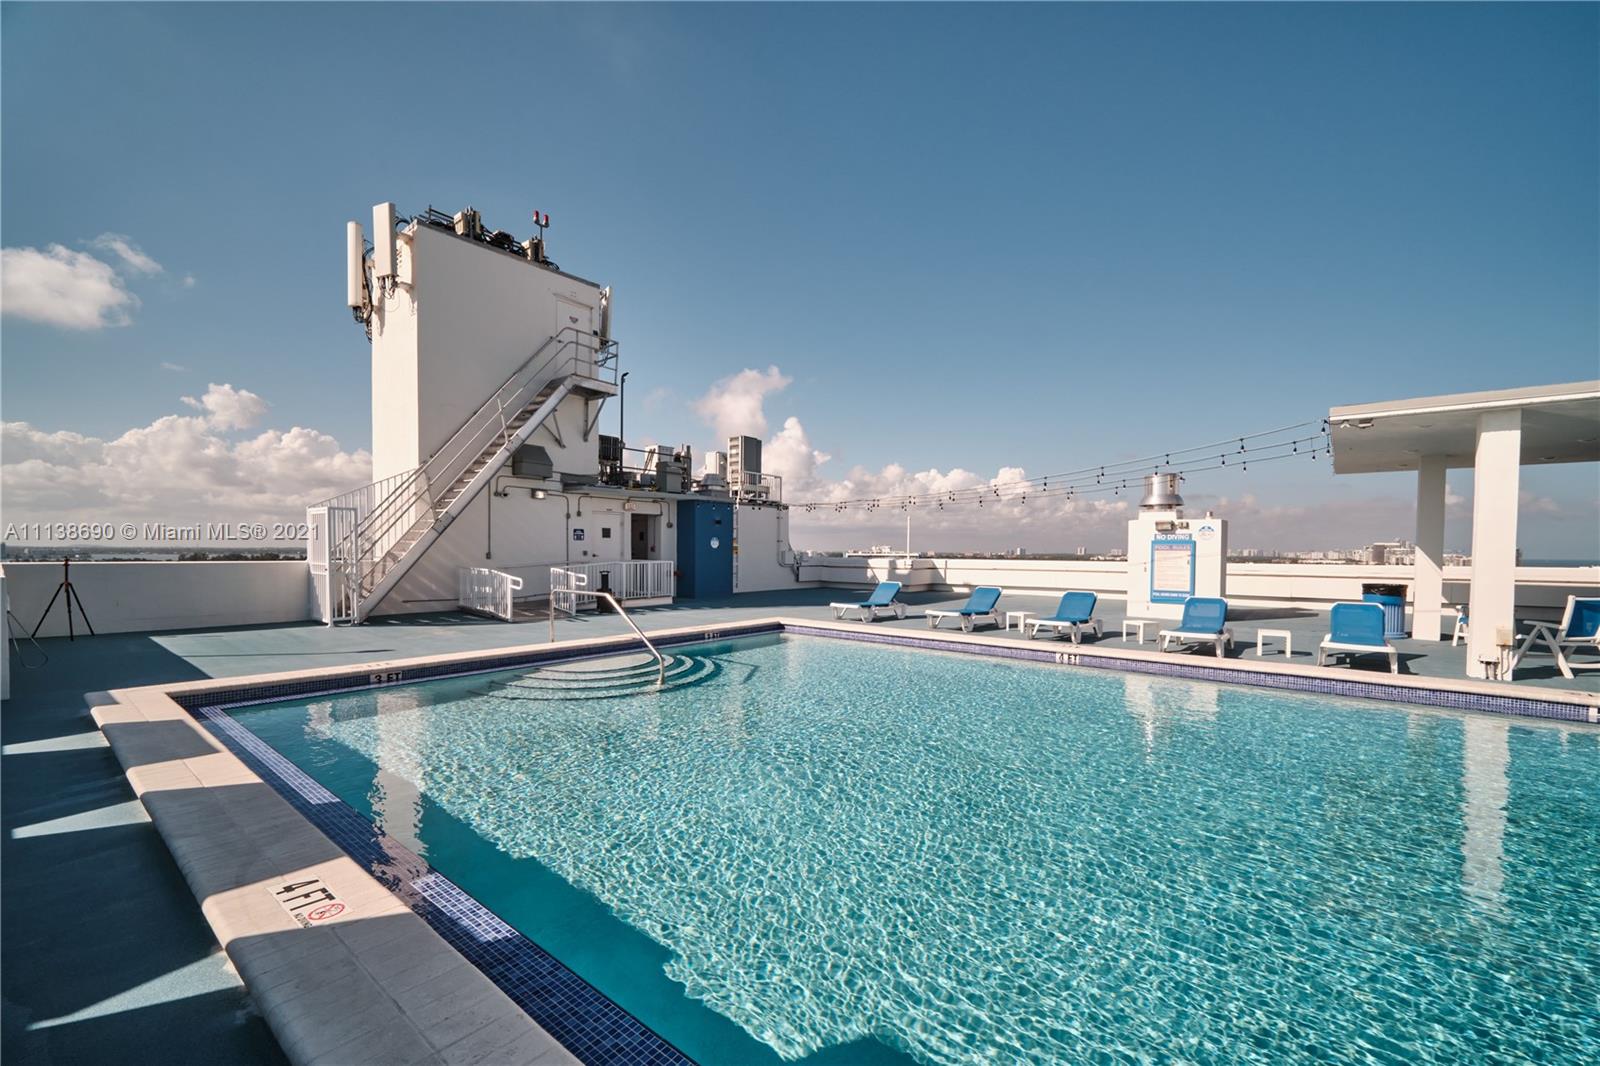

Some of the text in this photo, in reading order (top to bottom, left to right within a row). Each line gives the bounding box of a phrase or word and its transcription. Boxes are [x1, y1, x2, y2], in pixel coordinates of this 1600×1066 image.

[386, 672, 401, 683] FT
[276, 879, 336, 911] 4 FT
